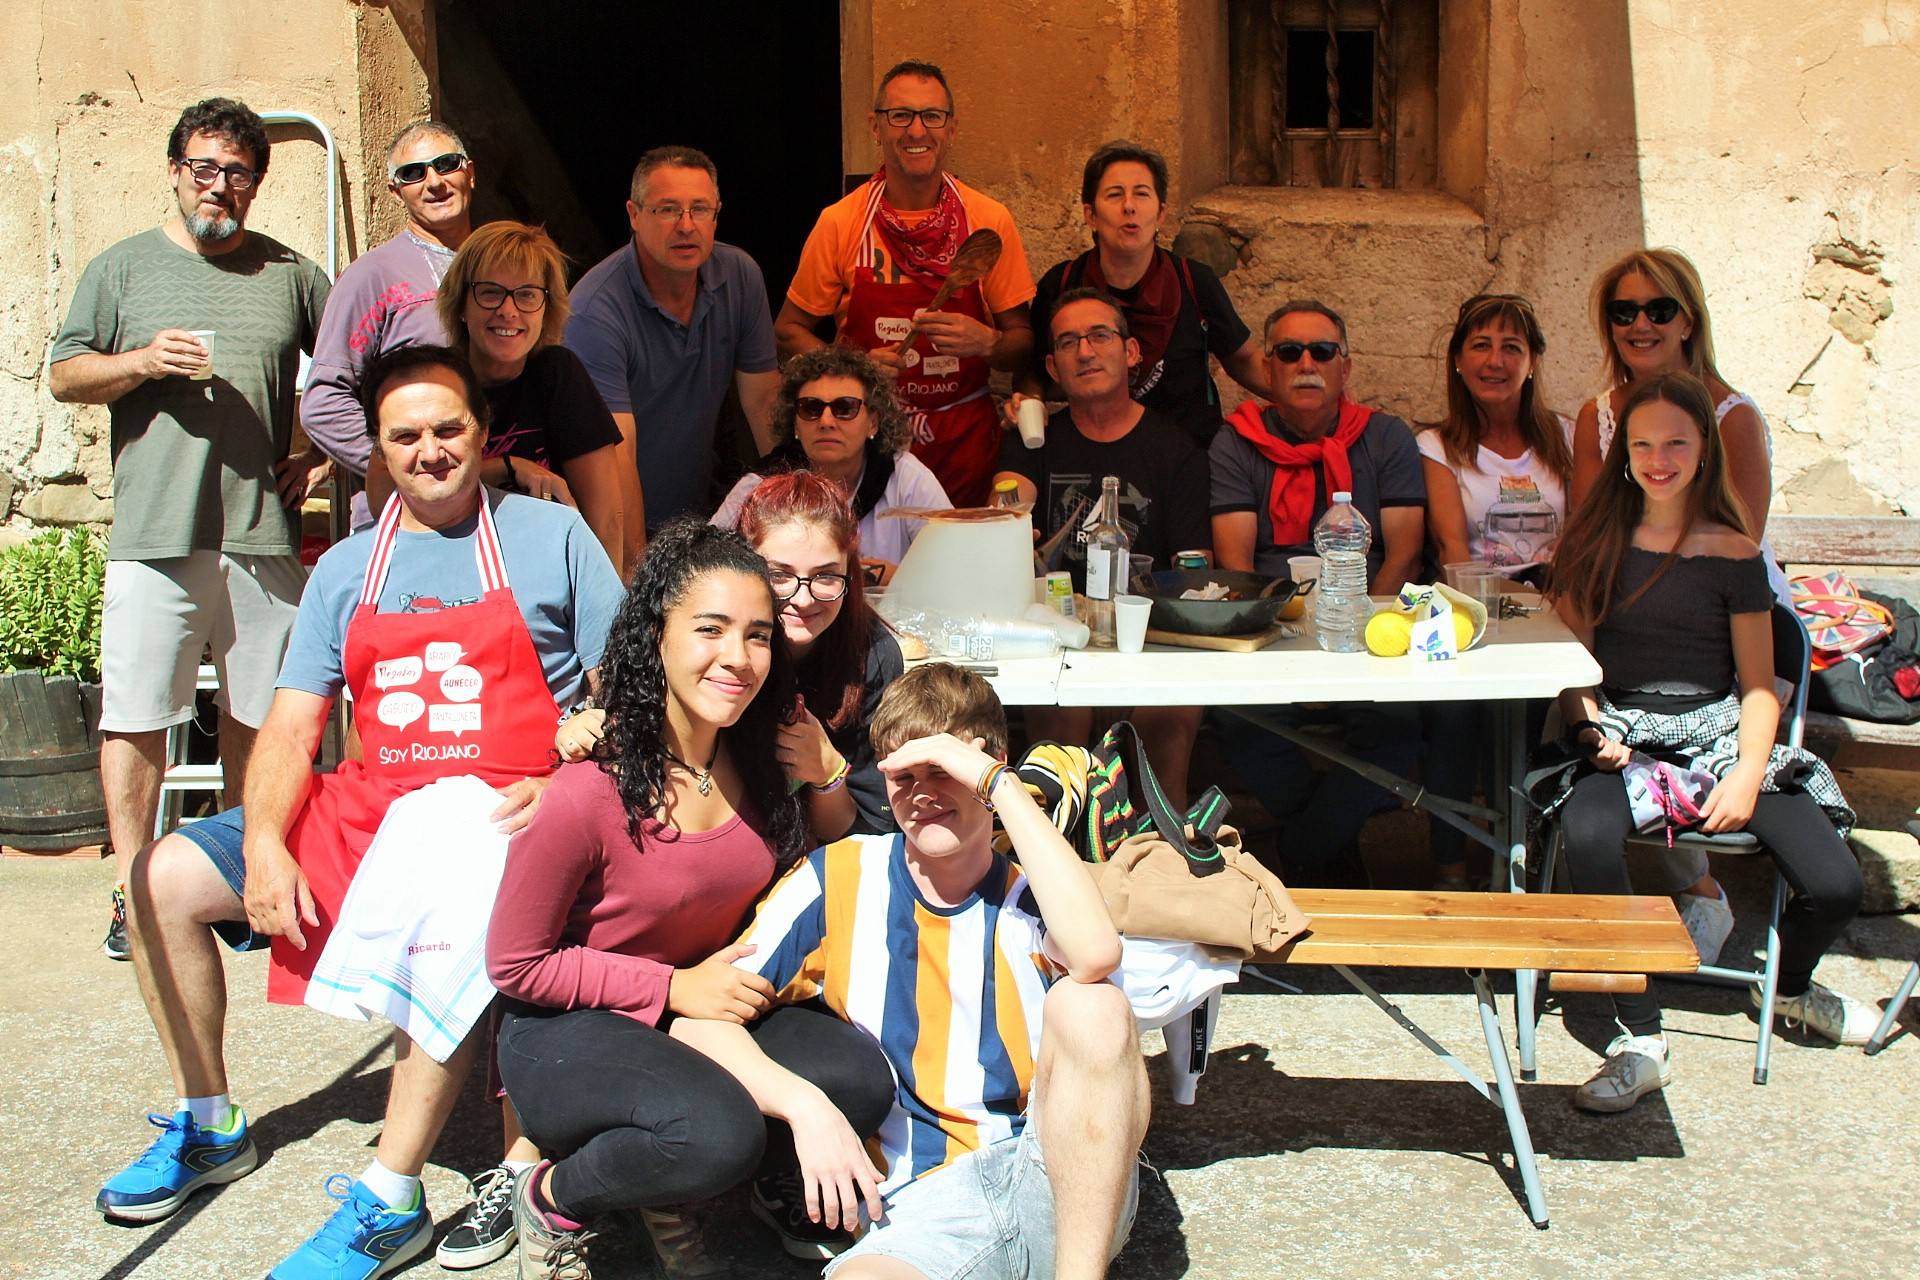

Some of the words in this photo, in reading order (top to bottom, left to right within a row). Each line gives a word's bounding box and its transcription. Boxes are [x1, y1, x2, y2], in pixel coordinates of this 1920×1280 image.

[907, 381, 959, 395] RIOJANO
[379, 747, 408, 764] SOY
[412, 743, 480, 761] RIOJANO
[408, 942, 451, 955] Ricardo
[1195, 1027, 1204, 1051] NIKE
